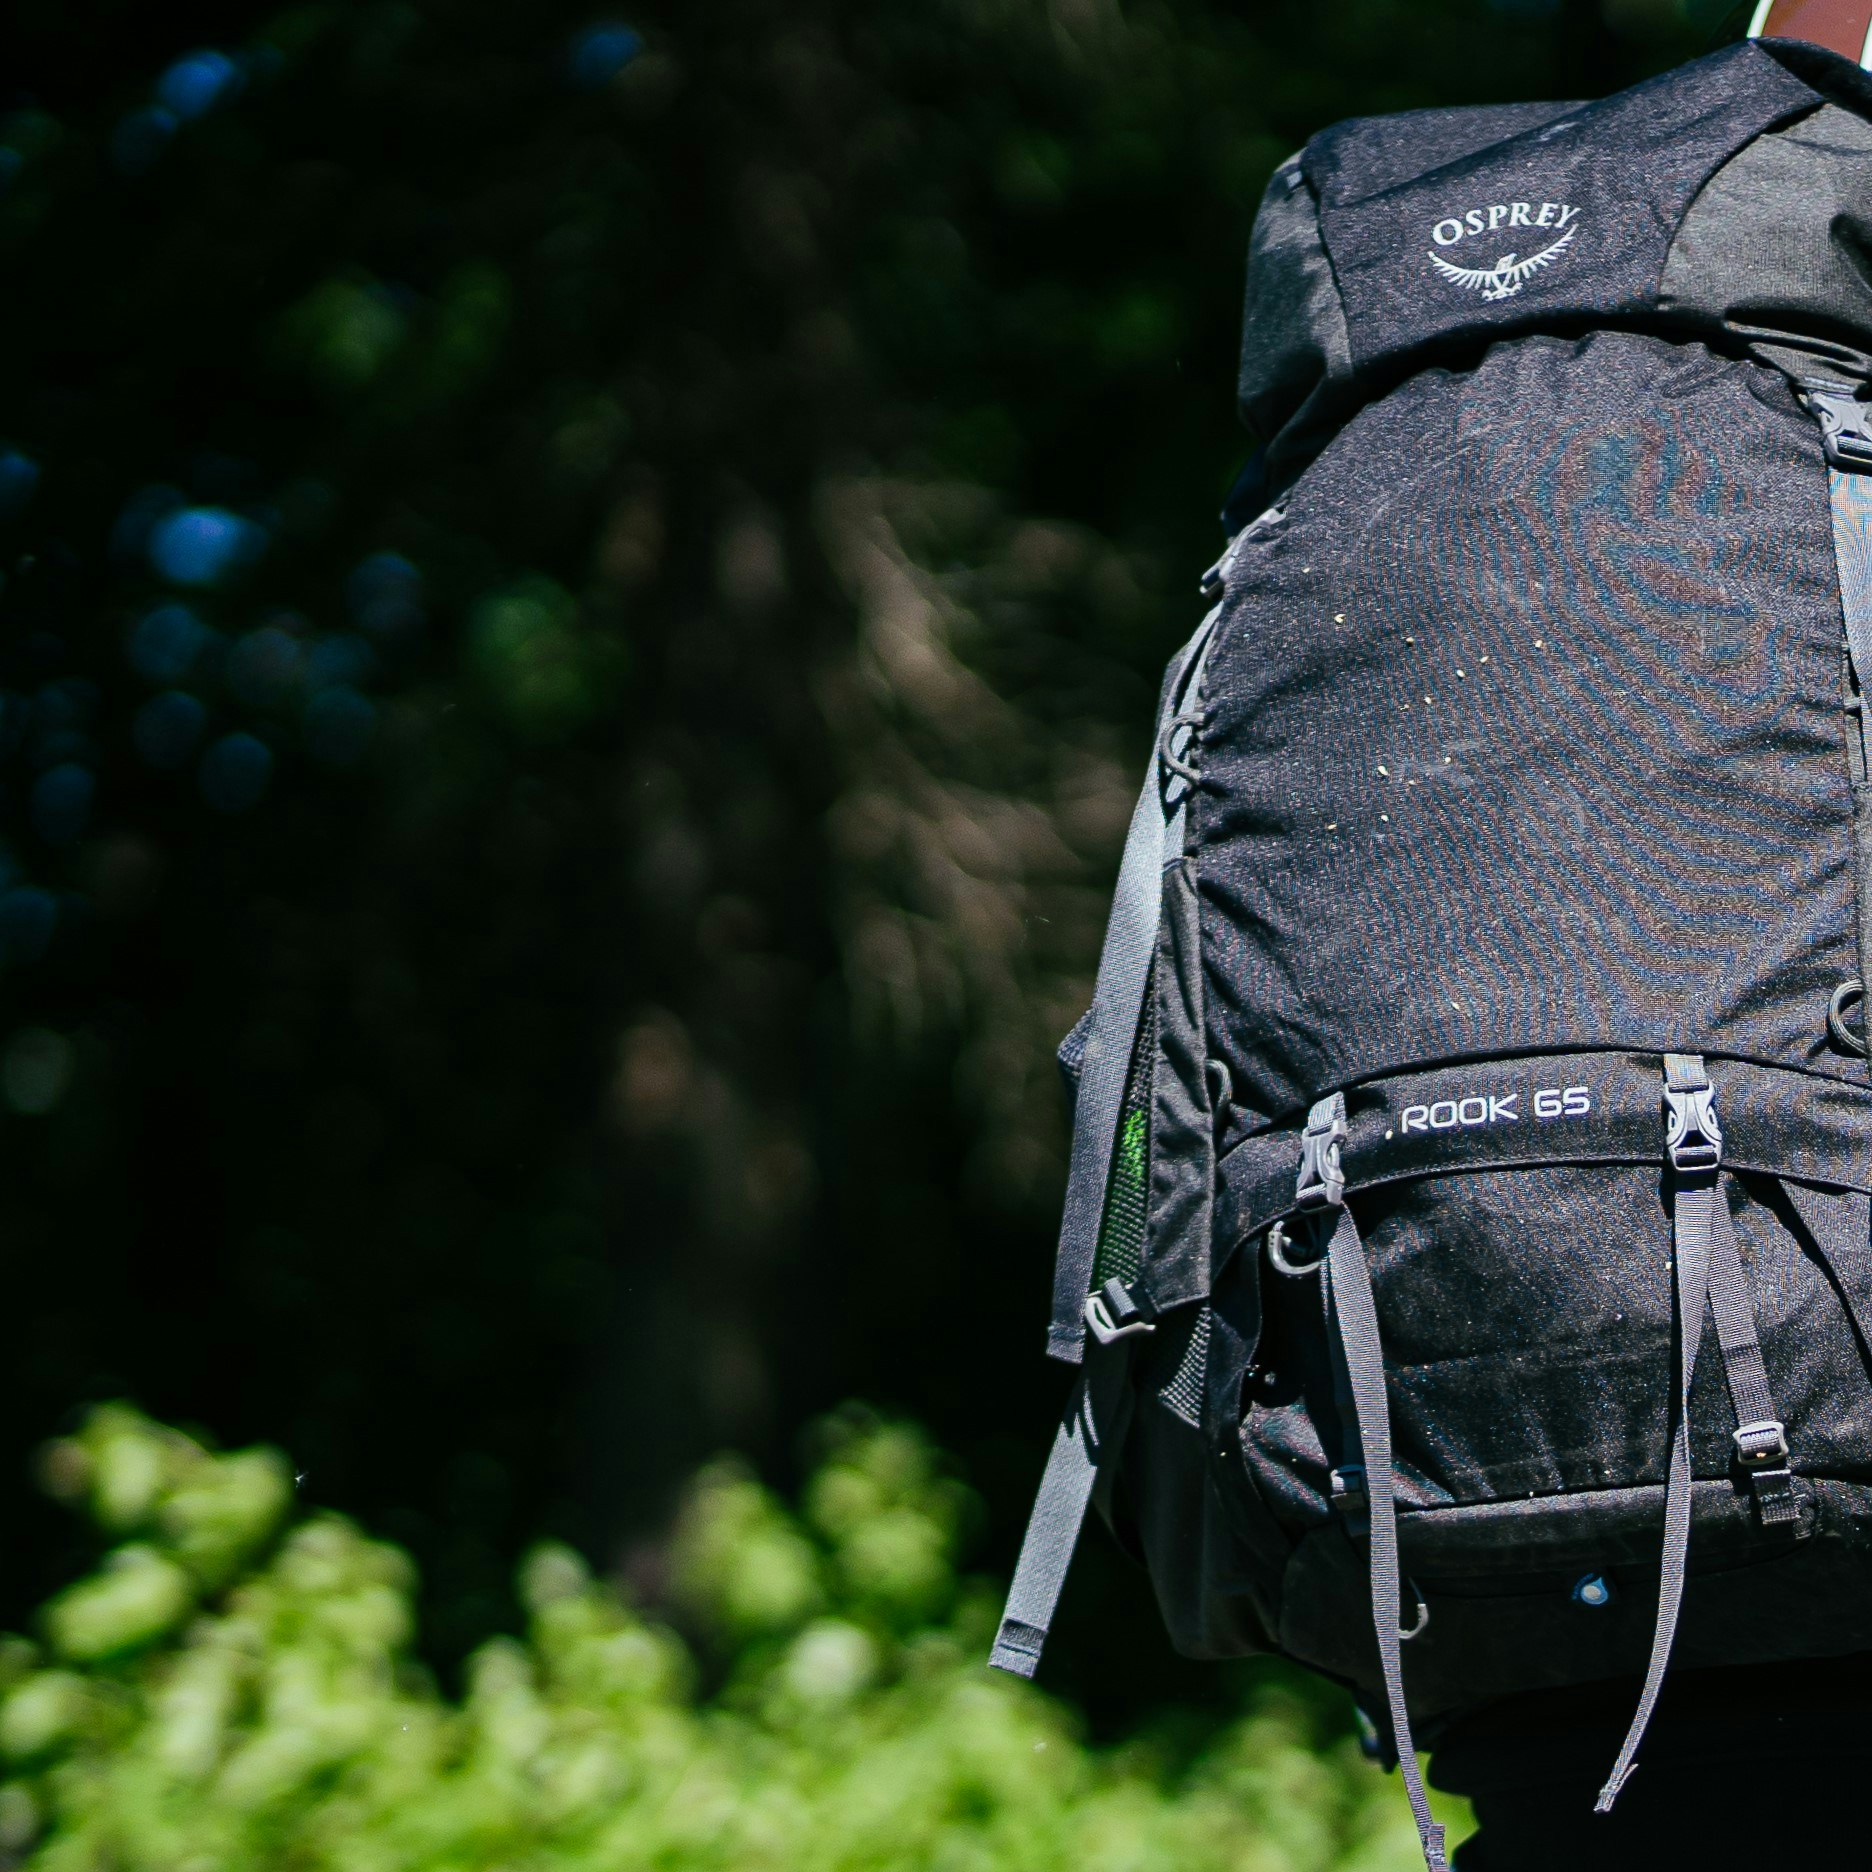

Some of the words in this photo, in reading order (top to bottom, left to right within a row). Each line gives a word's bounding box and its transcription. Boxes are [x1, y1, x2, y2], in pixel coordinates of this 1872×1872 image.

[1432, 202, 1581, 245] OSPREY
[1401, 1093, 1518, 1133] ROOK
[1533, 1086, 1589, 1117] 65
